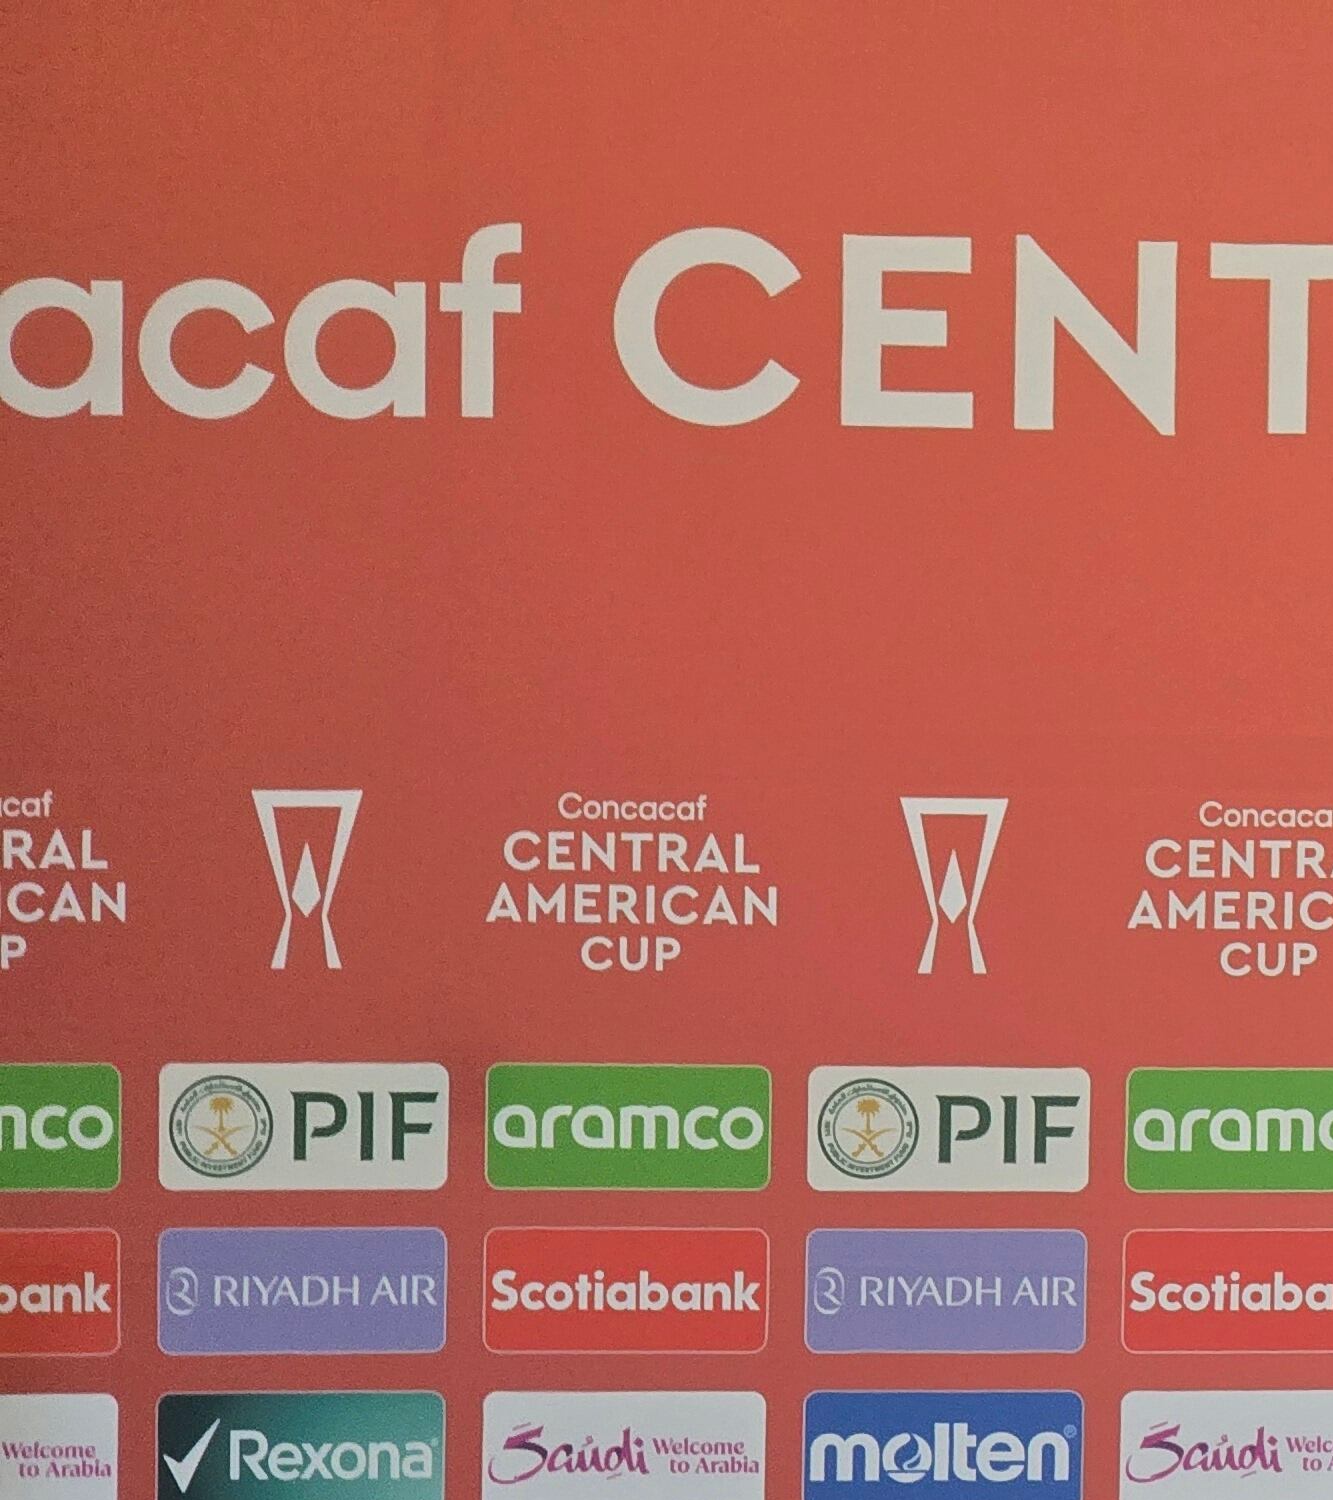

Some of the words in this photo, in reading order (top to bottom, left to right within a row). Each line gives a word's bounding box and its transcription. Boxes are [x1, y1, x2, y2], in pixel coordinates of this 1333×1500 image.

[558, 792, 706, 820] Concacaf
[504, 831, 760, 873] CENTRAL
[486, 883, 777, 926] AMERICAN
[581, 936, 680, 971] CUP
[1220, 942, 1317, 976] CUP
[291, 1092, 438, 1161] PIF
[493, 1105, 764, 1150] aramco
[936, 1095, 1080, 1163] PIF
[214, 1276, 359, 1306] RIYADH
[371, 1275, 436, 1305] AIR
[492, 1270, 760, 1310] Scotiabank
[861, 1277, 1001, 1306] RIYADH
[1013, 1277, 1076, 1306] AIR
[230, 1430, 433, 1481] Rexona
[652, 1438, 745, 1455] Welcome
[669, 1458, 691, 1474] to
[697, 1456, 760, 1474] Arabia
[810, 1423, 1069, 1483] molten
